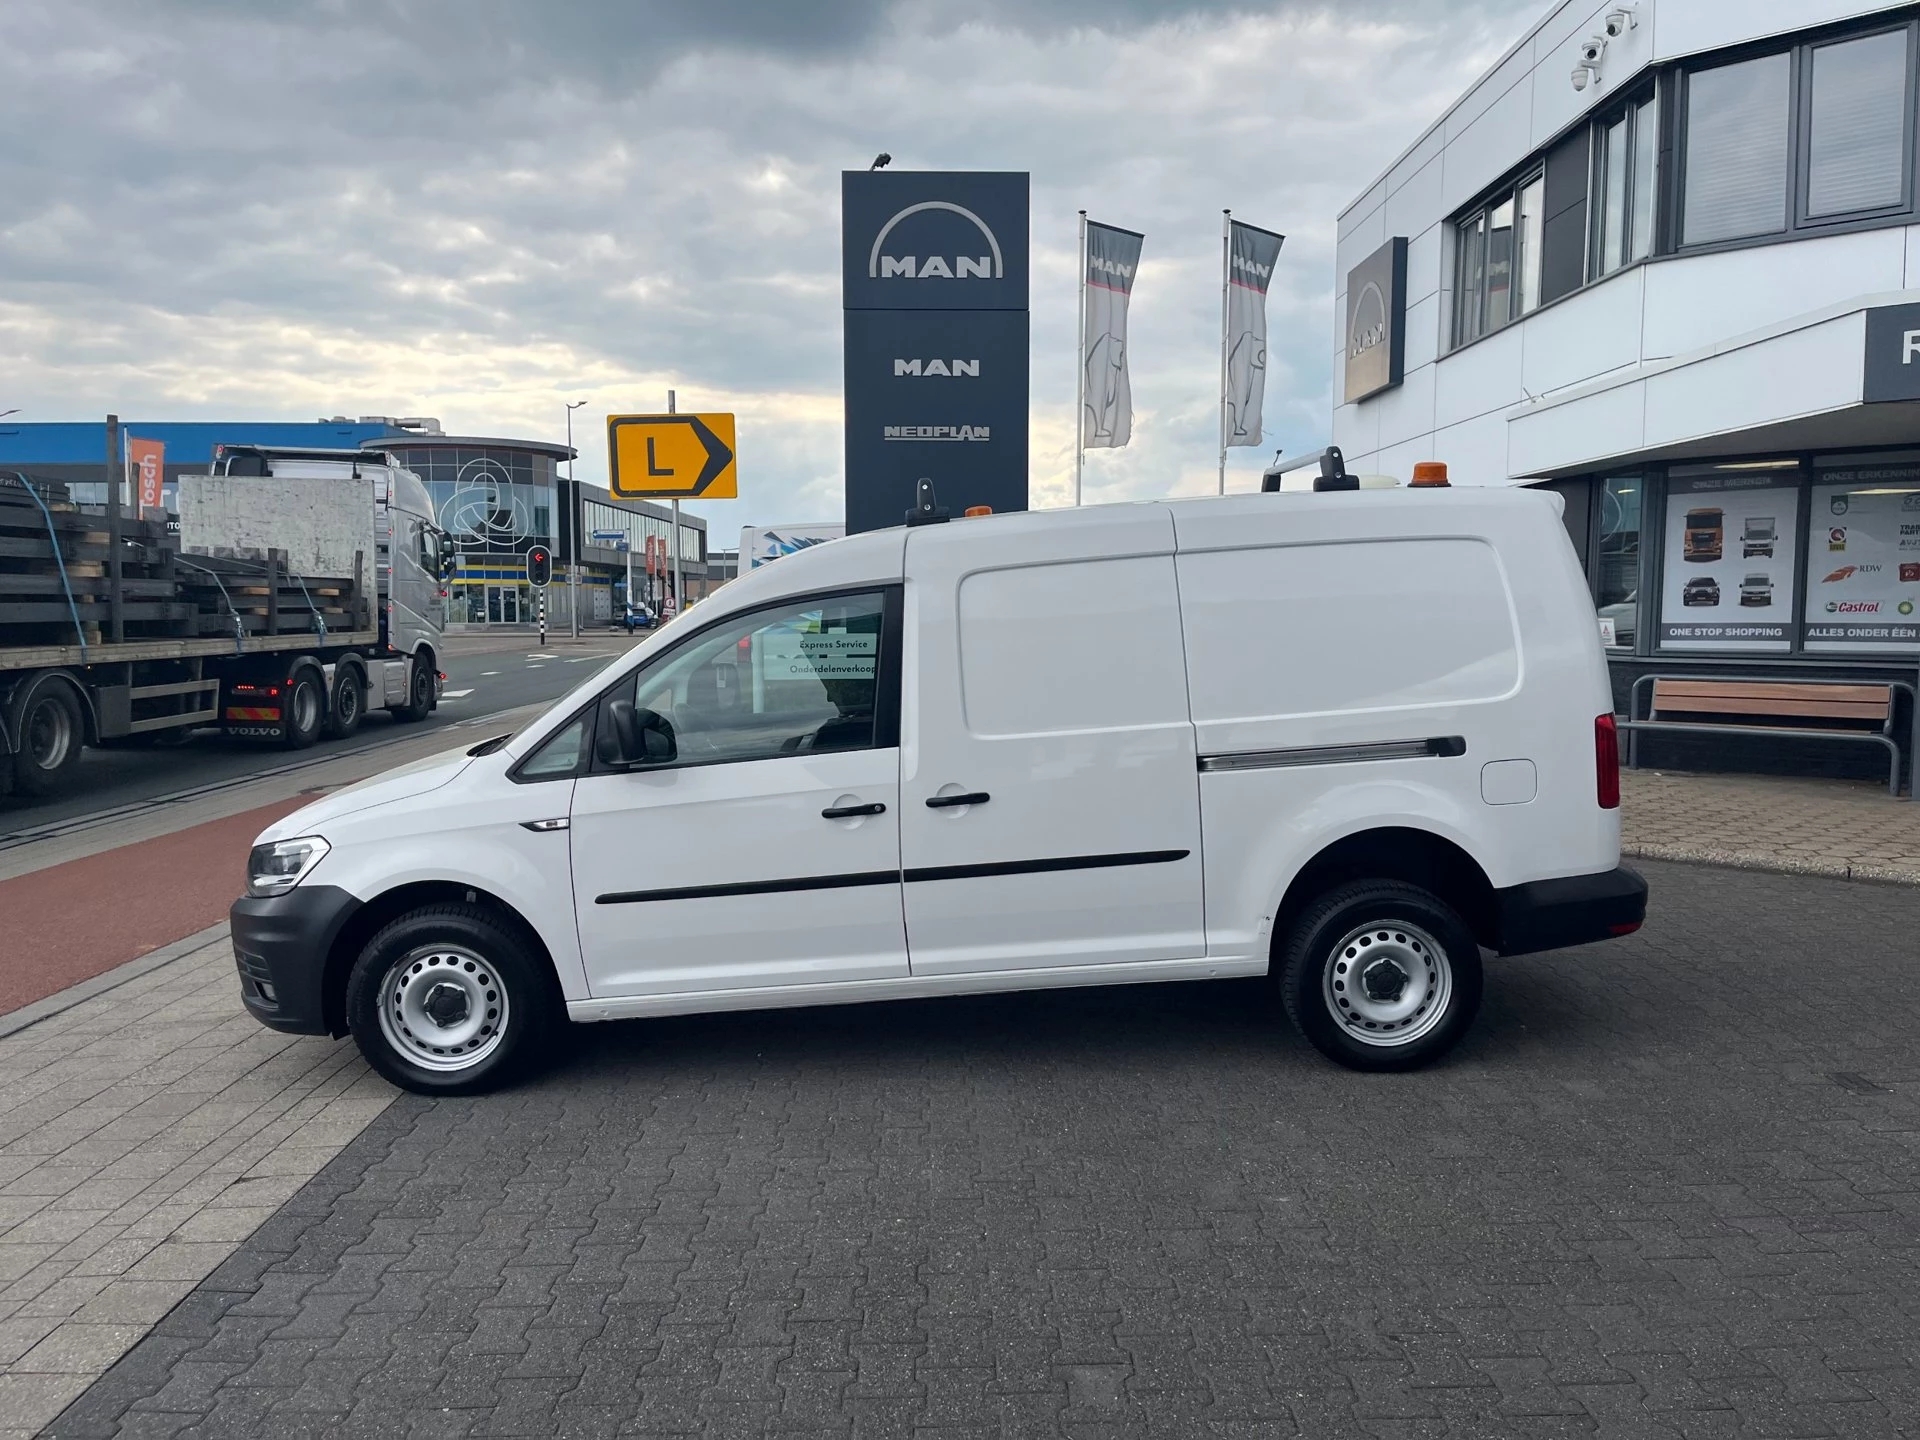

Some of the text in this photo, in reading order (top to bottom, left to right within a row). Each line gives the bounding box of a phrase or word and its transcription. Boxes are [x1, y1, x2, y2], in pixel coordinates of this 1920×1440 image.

[881, 256, 991, 279] MAN
[1090, 255, 1132, 278] MAN
[1232, 254, 1270, 278] MAN
[894, 359, 980, 377] MAN
[884, 425, 990, 441] NEOPLAN
[647, 437, 674, 476] L
[1823, 471, 1854, 481] ONZE
[1838, 602, 1879, 612] Castrol
[1669, 627, 1783, 636] ONE STOP SHOPPING
[1807, 626, 1916, 637] ALLES ONDER ÉÉN
[800, 640, 868, 650] Express Service
[228, 727, 281, 736] VOLVO
